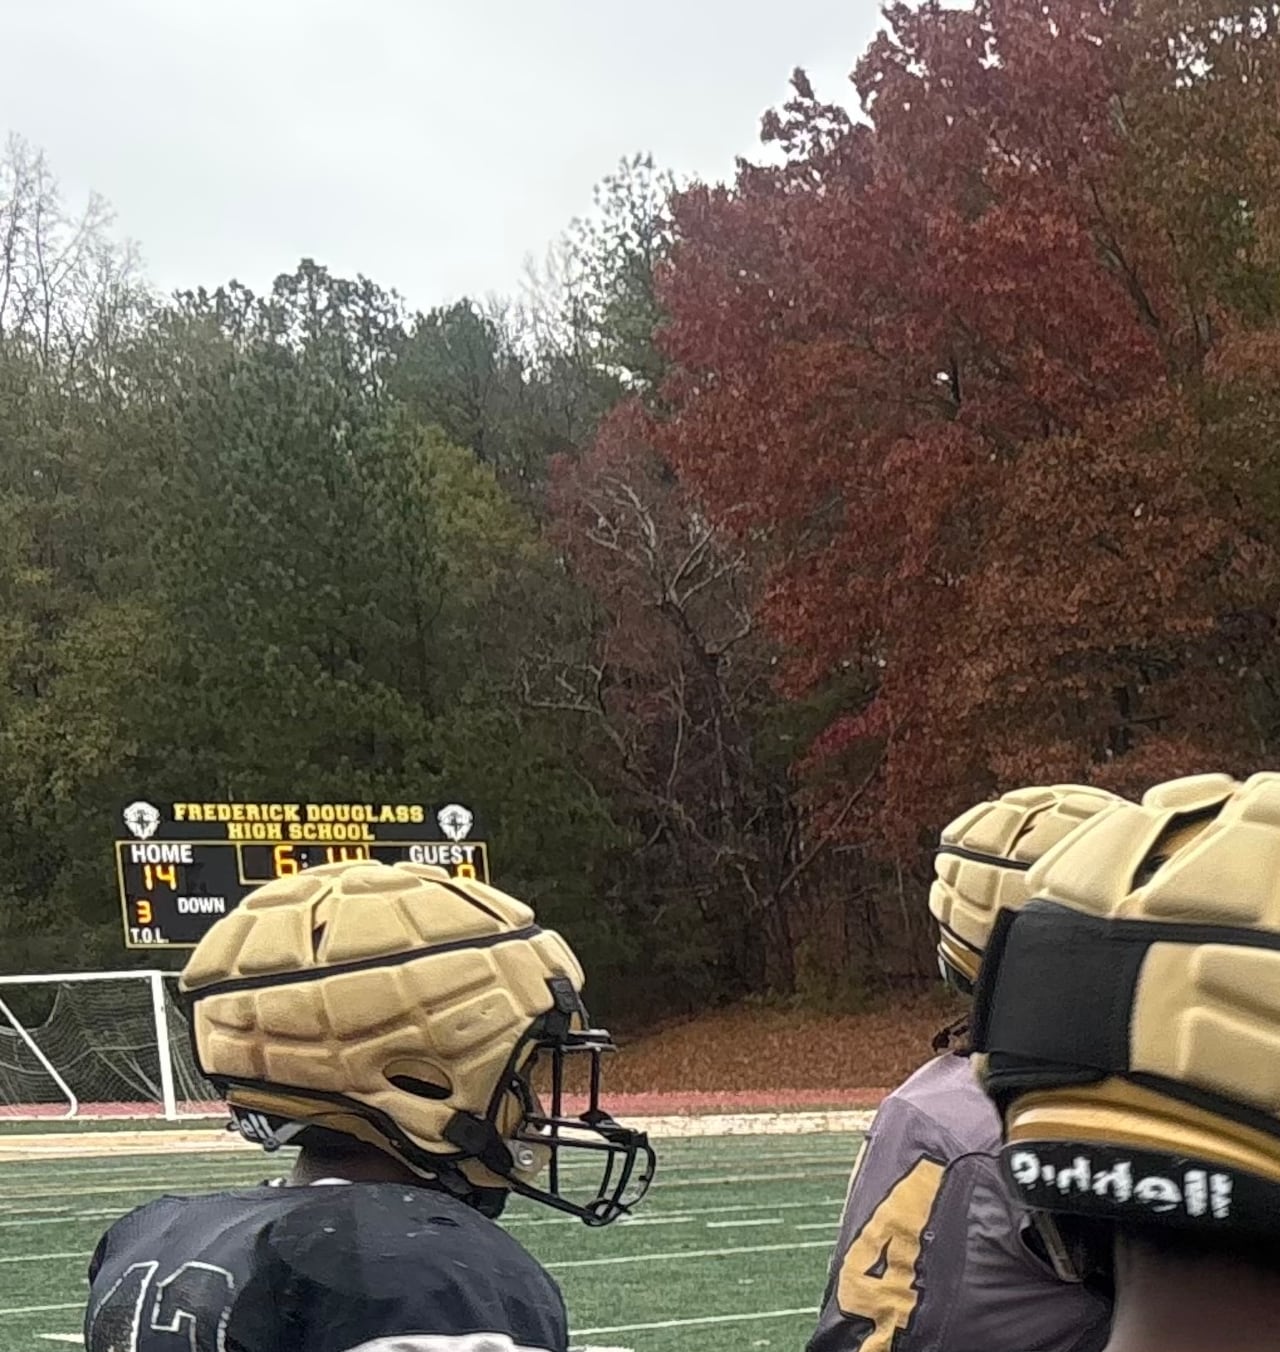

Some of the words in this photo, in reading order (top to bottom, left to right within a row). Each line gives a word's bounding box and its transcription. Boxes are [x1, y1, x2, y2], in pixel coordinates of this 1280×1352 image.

[173, 803, 300, 822] FREDERICK
[306, 804, 424, 823] DOUGLASS
[227, 822, 282, 840] HIGH
[288, 823, 375, 840] SCHOOL
[131, 844, 193, 864] HOME
[409, 844, 475, 865] GUEST
[143, 865, 177, 890] 14
[135, 900, 152, 924] 3
[177, 896, 226, 914] DOWN
